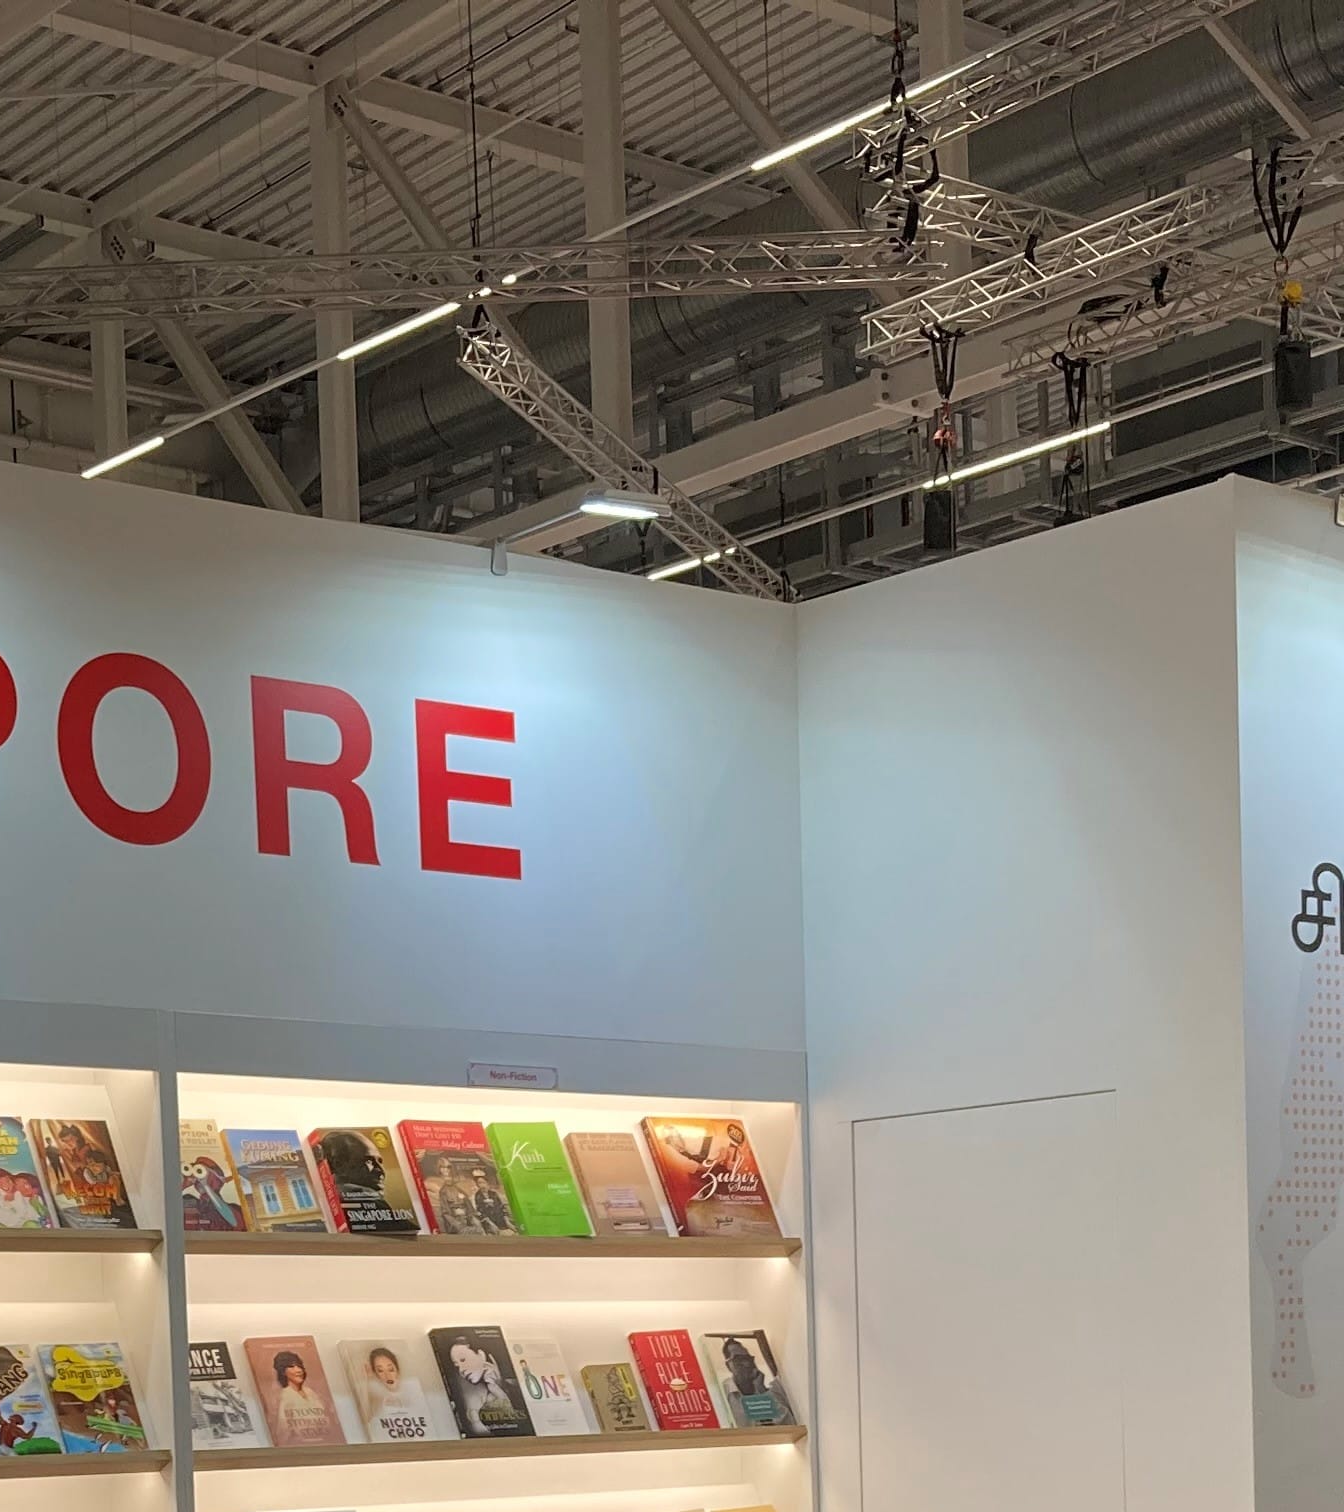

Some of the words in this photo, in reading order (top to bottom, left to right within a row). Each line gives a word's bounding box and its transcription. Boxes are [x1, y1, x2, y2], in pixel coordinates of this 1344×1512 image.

[489, 1070, 537, 1082] Non-Fiction
[346, 1209, 393, 1222] SINGAPORE
[394, 1208, 414, 1221] LION
[647, 1334, 681, 1358] TINY
[657, 1360, 692, 1384] RICE
[656, 1387, 712, 1415] GRAINS
[380, 1416, 428, 1429] NICOLE
[388, 1427, 425, 1438] CHOO
